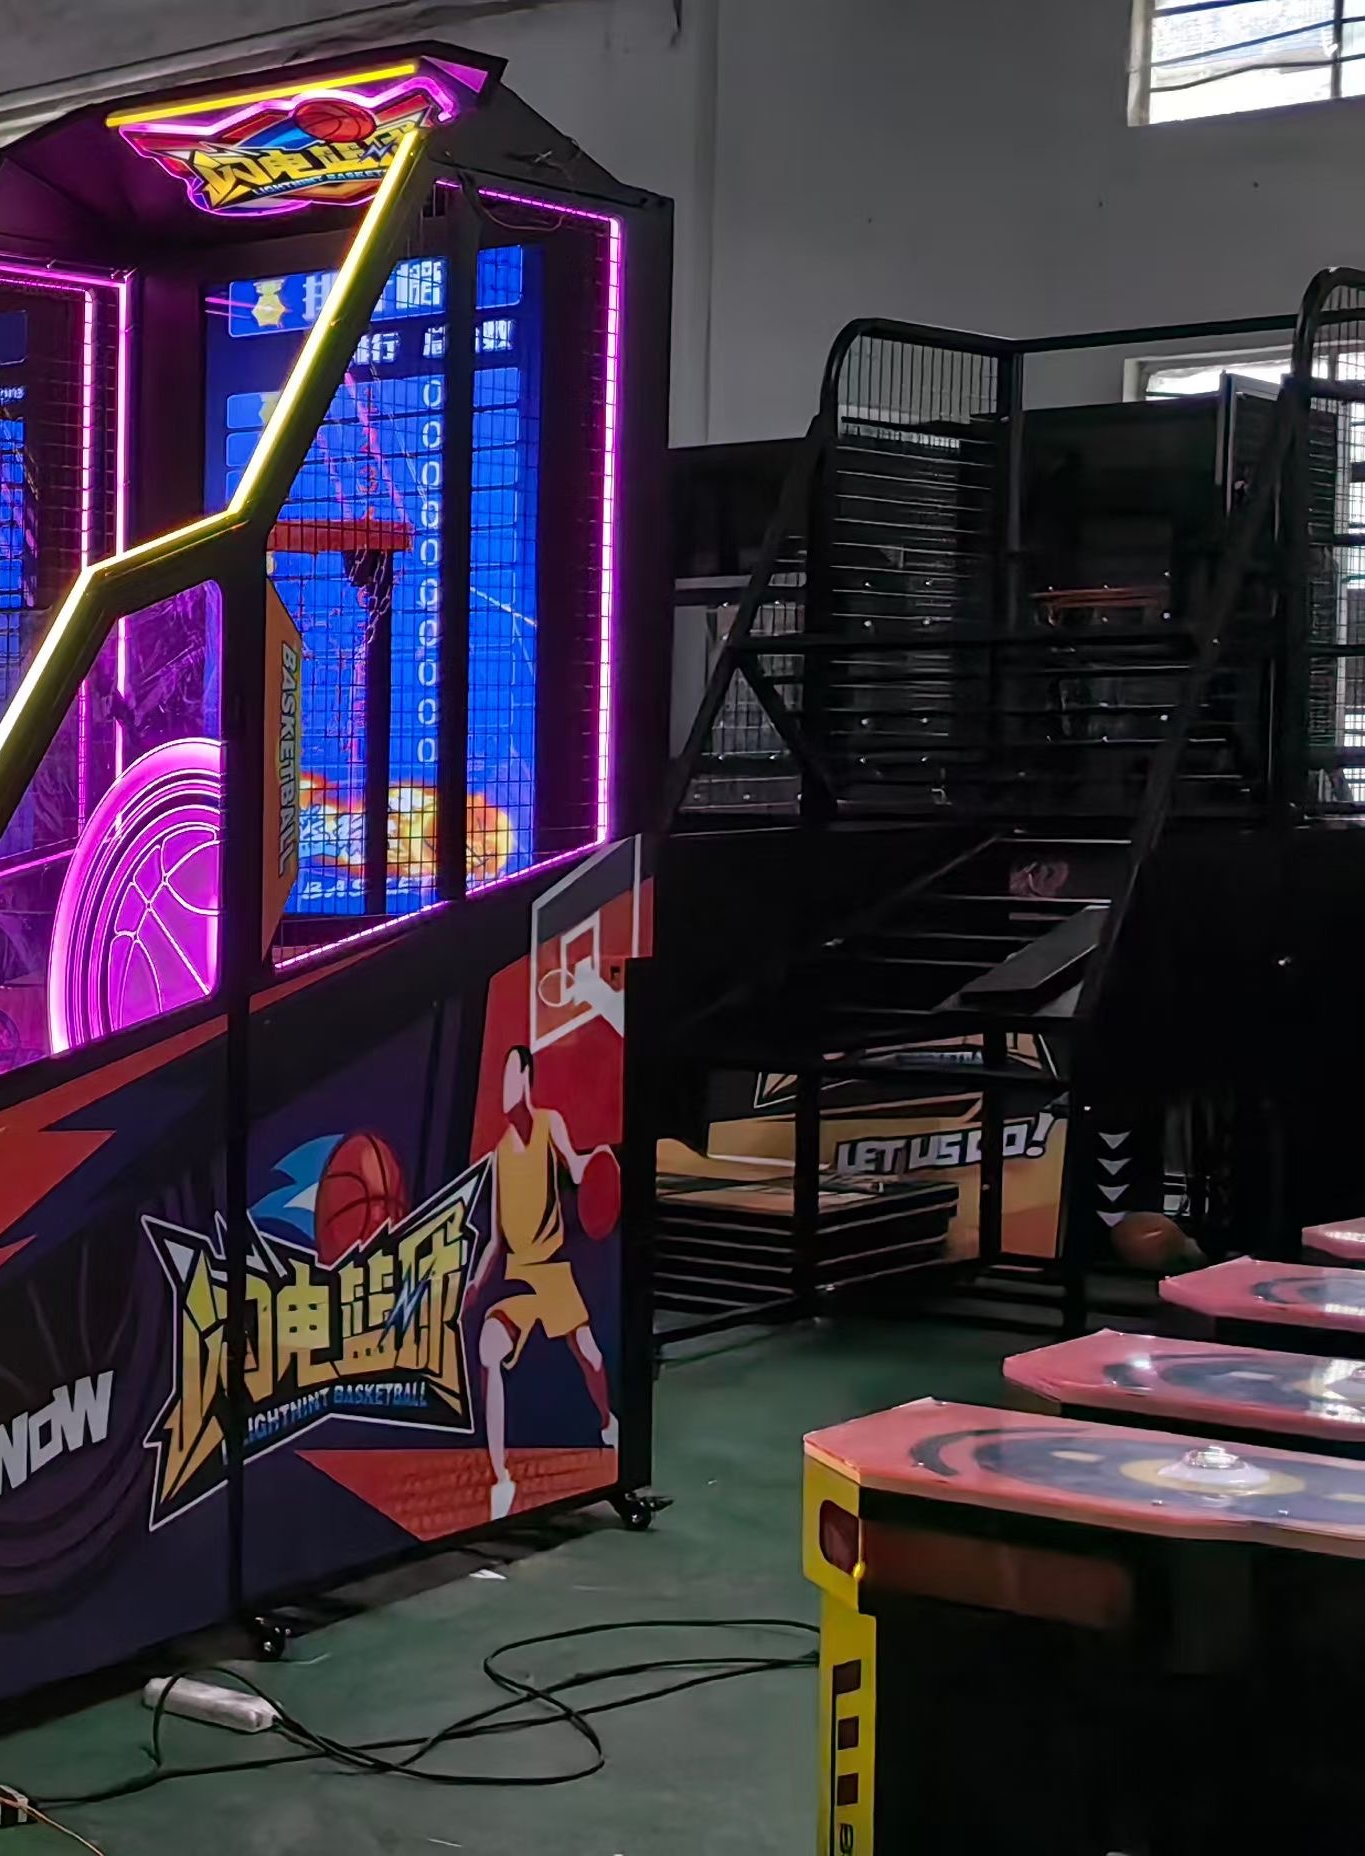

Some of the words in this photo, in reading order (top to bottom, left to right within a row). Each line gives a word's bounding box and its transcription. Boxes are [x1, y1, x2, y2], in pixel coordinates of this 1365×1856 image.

[326, 167, 387, 183] BASKET
[423, 379, 441, 407] 0
[422, 420, 440, 448] 0
[422, 460, 439, 487] 0
[421, 500, 439, 528] 0
[420, 538, 439, 566] 0
[419, 577, 438, 607] 0
[419, 619, 438, 647] 0
[418, 658, 437, 687] 0
[417, 698, 436, 725] 0
[278, 640, 298, 879] BASKETBALL
[416, 737, 436, 763] 0
[836, 1138, 908, 1176] LET
[908, 1129, 963, 1170] US
[243, 1386, 330, 1446] IGHTNINT
[332, 1380, 428, 1408] BASKETBALL
